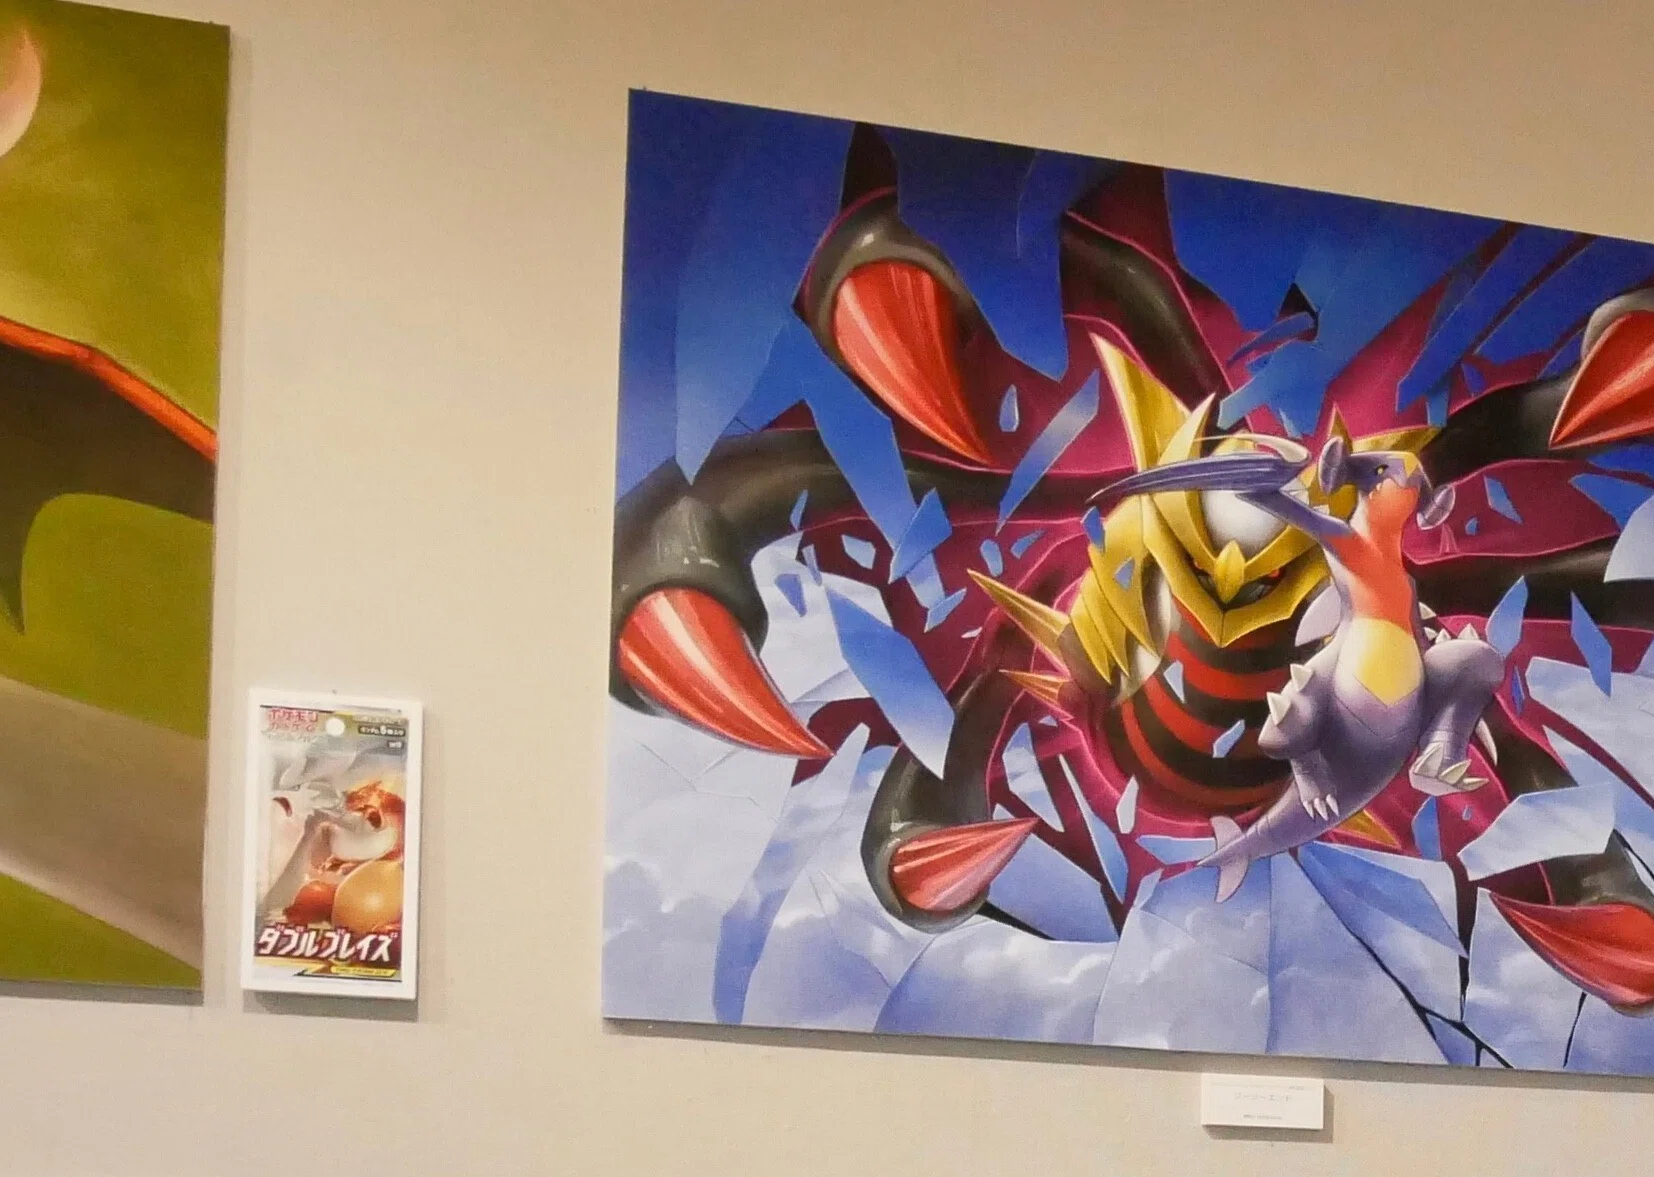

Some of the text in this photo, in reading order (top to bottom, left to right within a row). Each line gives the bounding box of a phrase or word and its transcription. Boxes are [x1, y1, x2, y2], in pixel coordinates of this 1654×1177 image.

[258, 924, 399, 963] ダブルブレイズ
